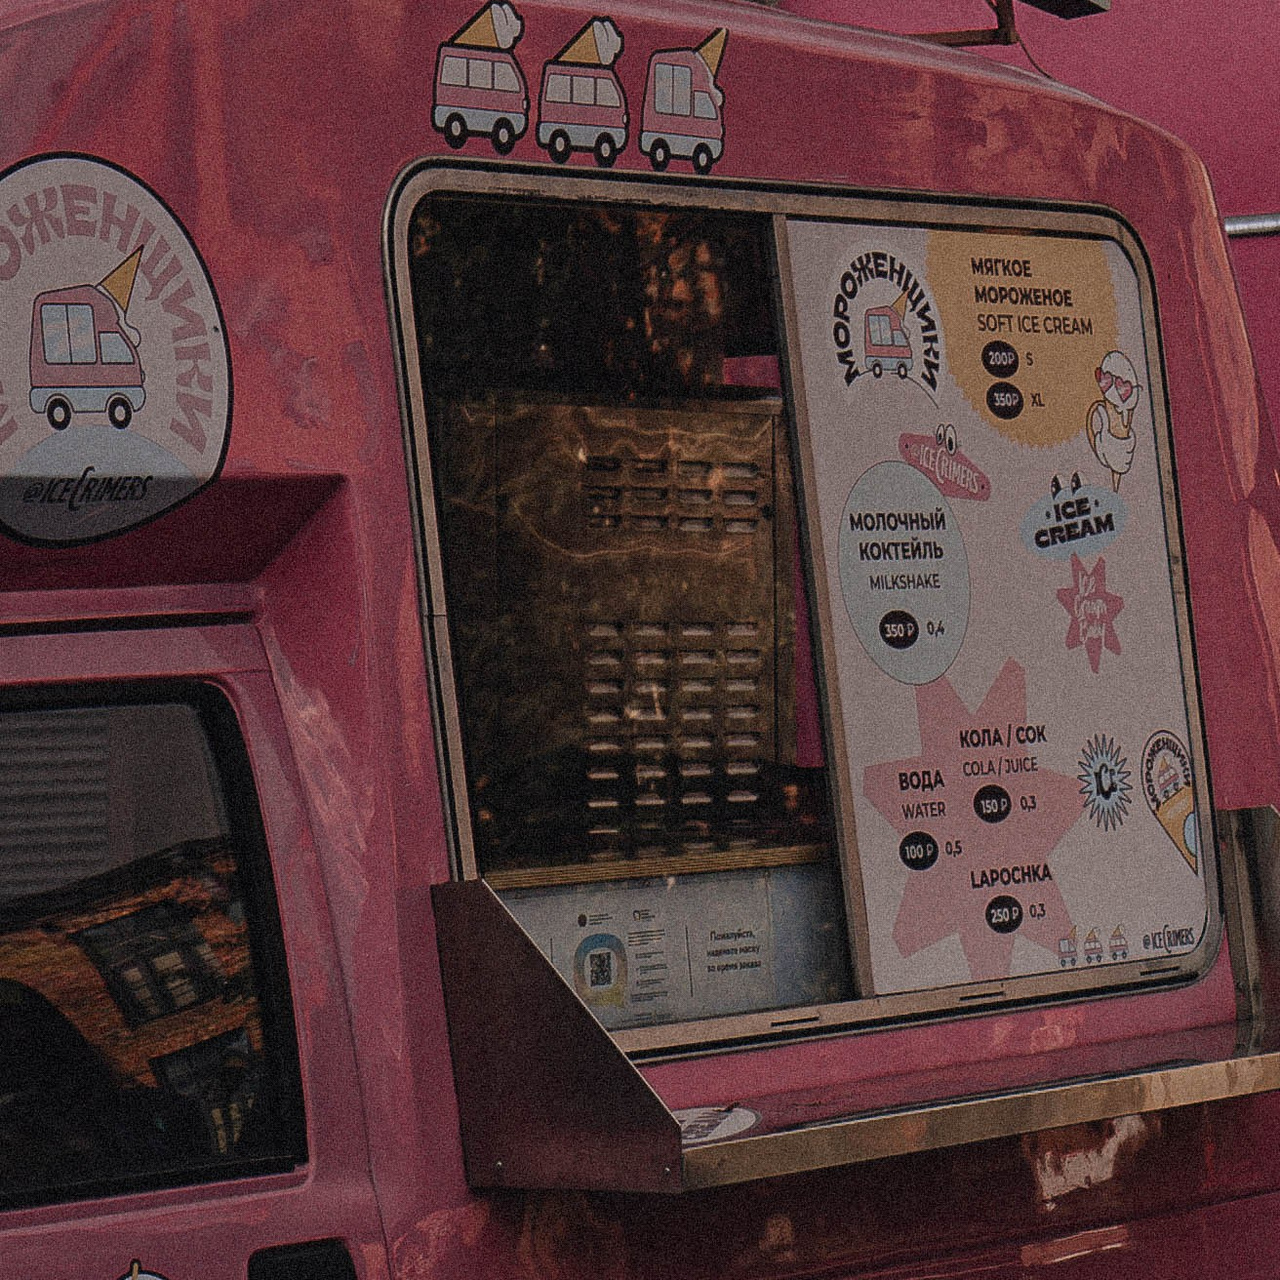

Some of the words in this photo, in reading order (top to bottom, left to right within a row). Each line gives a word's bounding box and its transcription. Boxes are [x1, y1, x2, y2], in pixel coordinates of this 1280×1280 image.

[971, 257, 1032, 278] МЯГКОЕ
[974, 286, 1073, 307] МОРОЖЕНОЕ
[833, 251, 940, 392] МОРОЖЕНЩИКИ
[977, 314, 1014, 332] SOFT
[1017, 315, 1041, 333] ICE
[1043, 316, 1094, 335] CREAM
[1025, 351, 1034, 366] S
[1030, 392, 1046, 407] XL
[849, 507, 947, 532] МОЛОЧНЫЙ
[1053, 497, 1091, 522] ICE
[1035, 513, 1115, 549] CREAM
[858, 537, 944, 561] КОКТЕЙЛЬ
[869, 573, 941, 590] MILKSHAKE
[884, 623, 905, 638] 350
[926, 620, 945, 638] 0,4
[959, 728, 1003, 748] КОЛА
[1016, 725, 1047, 744] СОК
[963, 760, 996, 777] COLA
[1004, 757, 1038, 774] JUICE
[898, 769, 945, 792] ВОДА
[901, 801, 946, 820] WATER
[980, 798, 998, 814] 150
[1020, 796, 1037, 813] 0,3
[904, 843, 924, 860] 100
[945, 840, 962, 857] 0,5
[970, 863, 1053, 889] LAPOCHKA
[990, 908, 1010, 923] 250
[1029, 903, 1046, 920] 0,3
